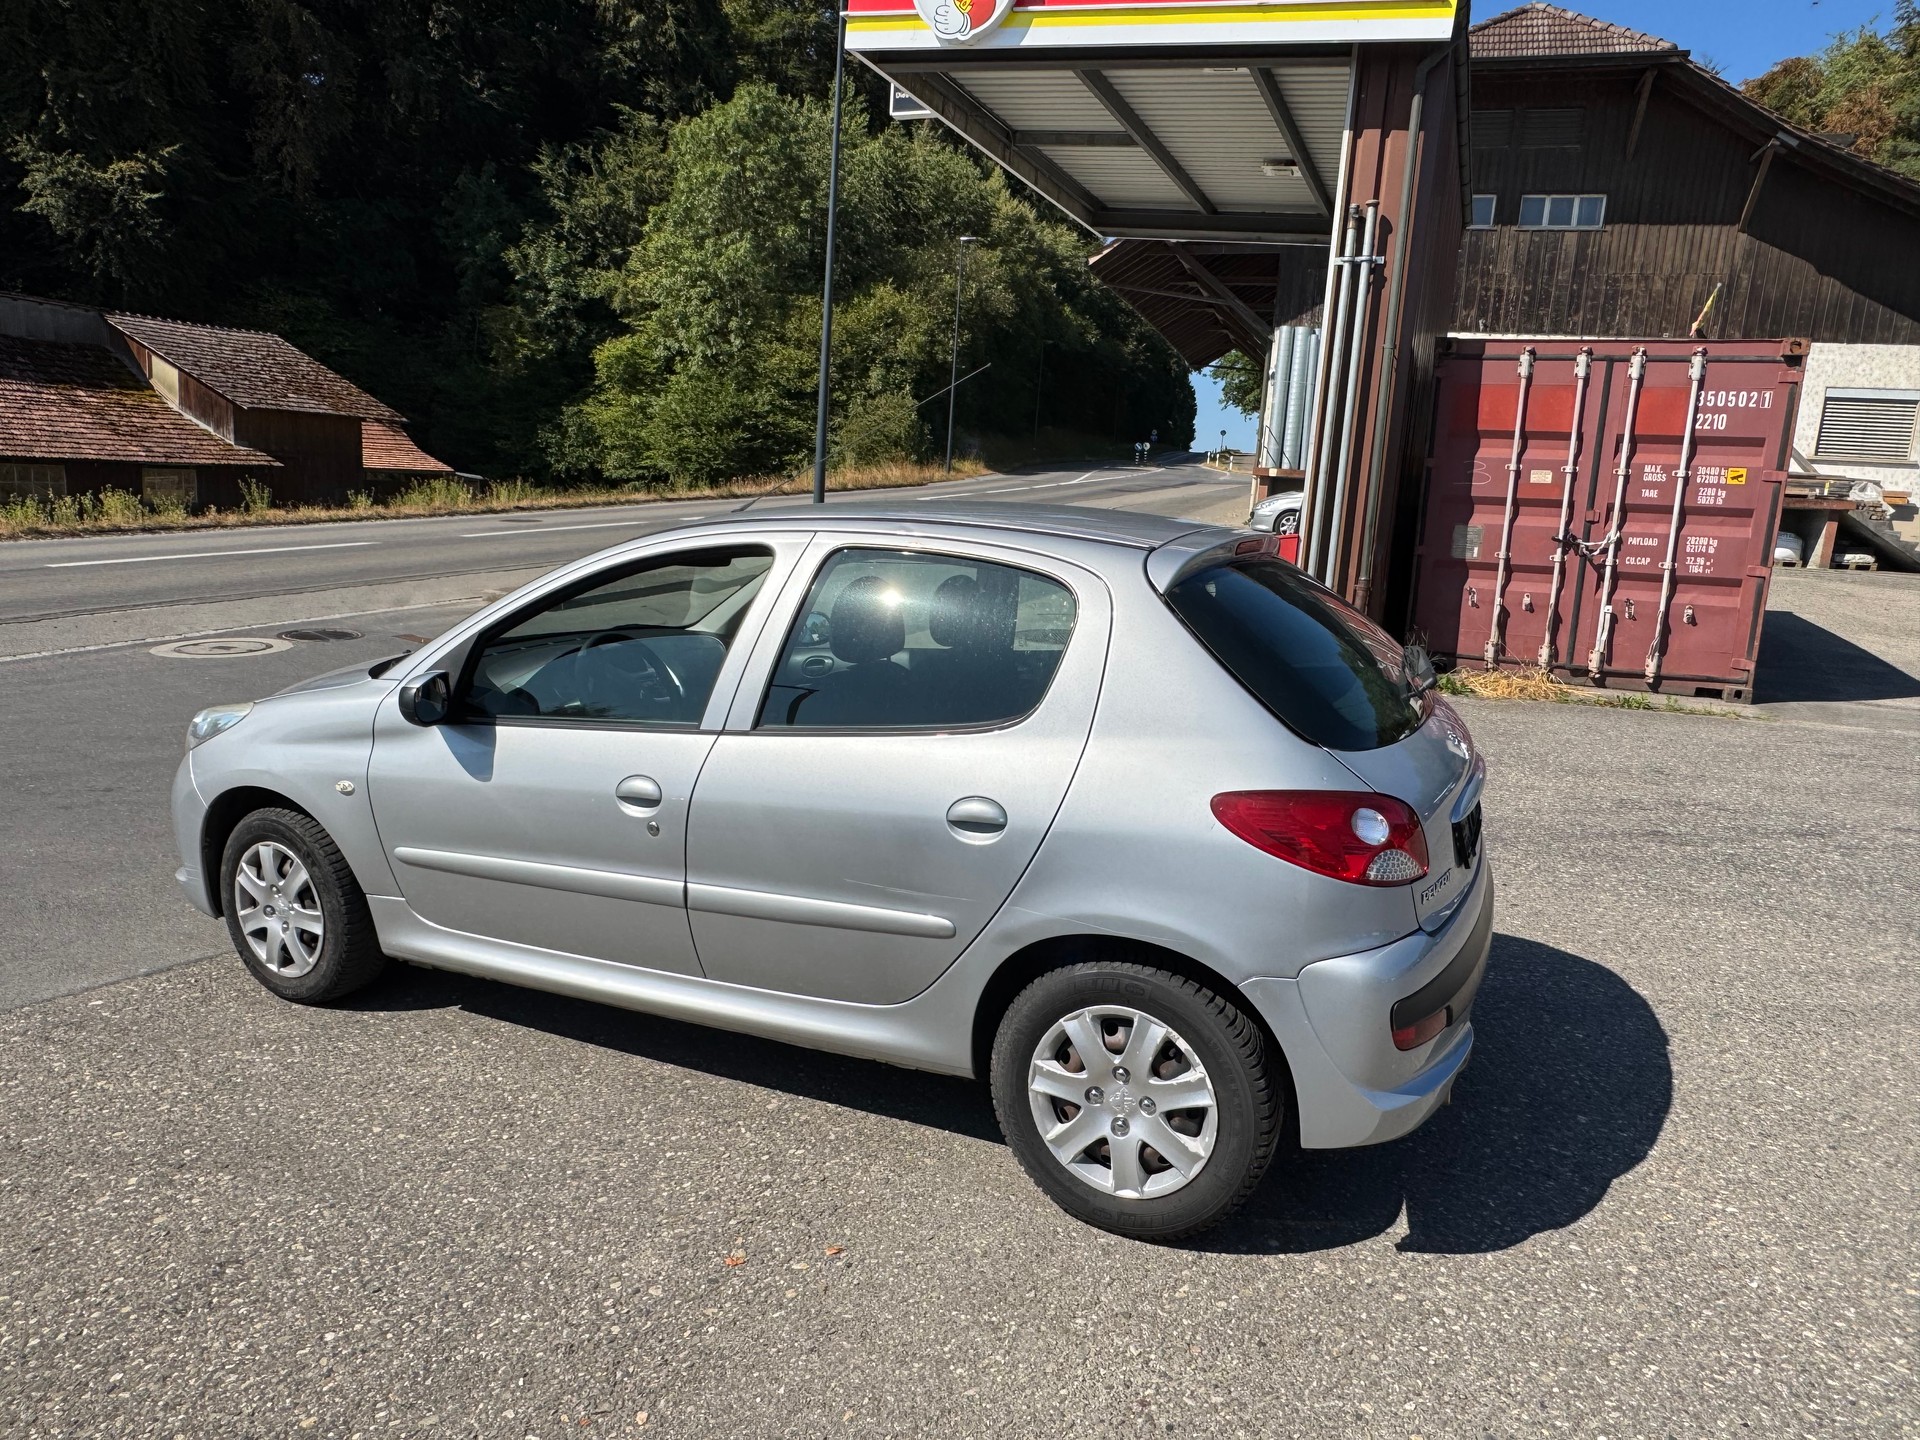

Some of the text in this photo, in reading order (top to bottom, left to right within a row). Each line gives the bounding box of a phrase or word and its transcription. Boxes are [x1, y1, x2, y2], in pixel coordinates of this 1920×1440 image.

[1695, 413, 1727, 430] 2210
[1644, 465, 1663, 474] MAX.
[1697, 466, 1719, 475] 30480
[1643, 473, 1667, 482] GROSS
[1697, 475, 1718, 484] 67200
[1641, 489, 1659, 498] TARE
[1698, 487, 1726, 499] 2280 kg
[1697, 496, 1715, 504] 5026
[1628, 537, 1658, 546] PAYLOAD
[1709, 537, 1718, 547] kg
[1708, 546, 1715, 554] lb
